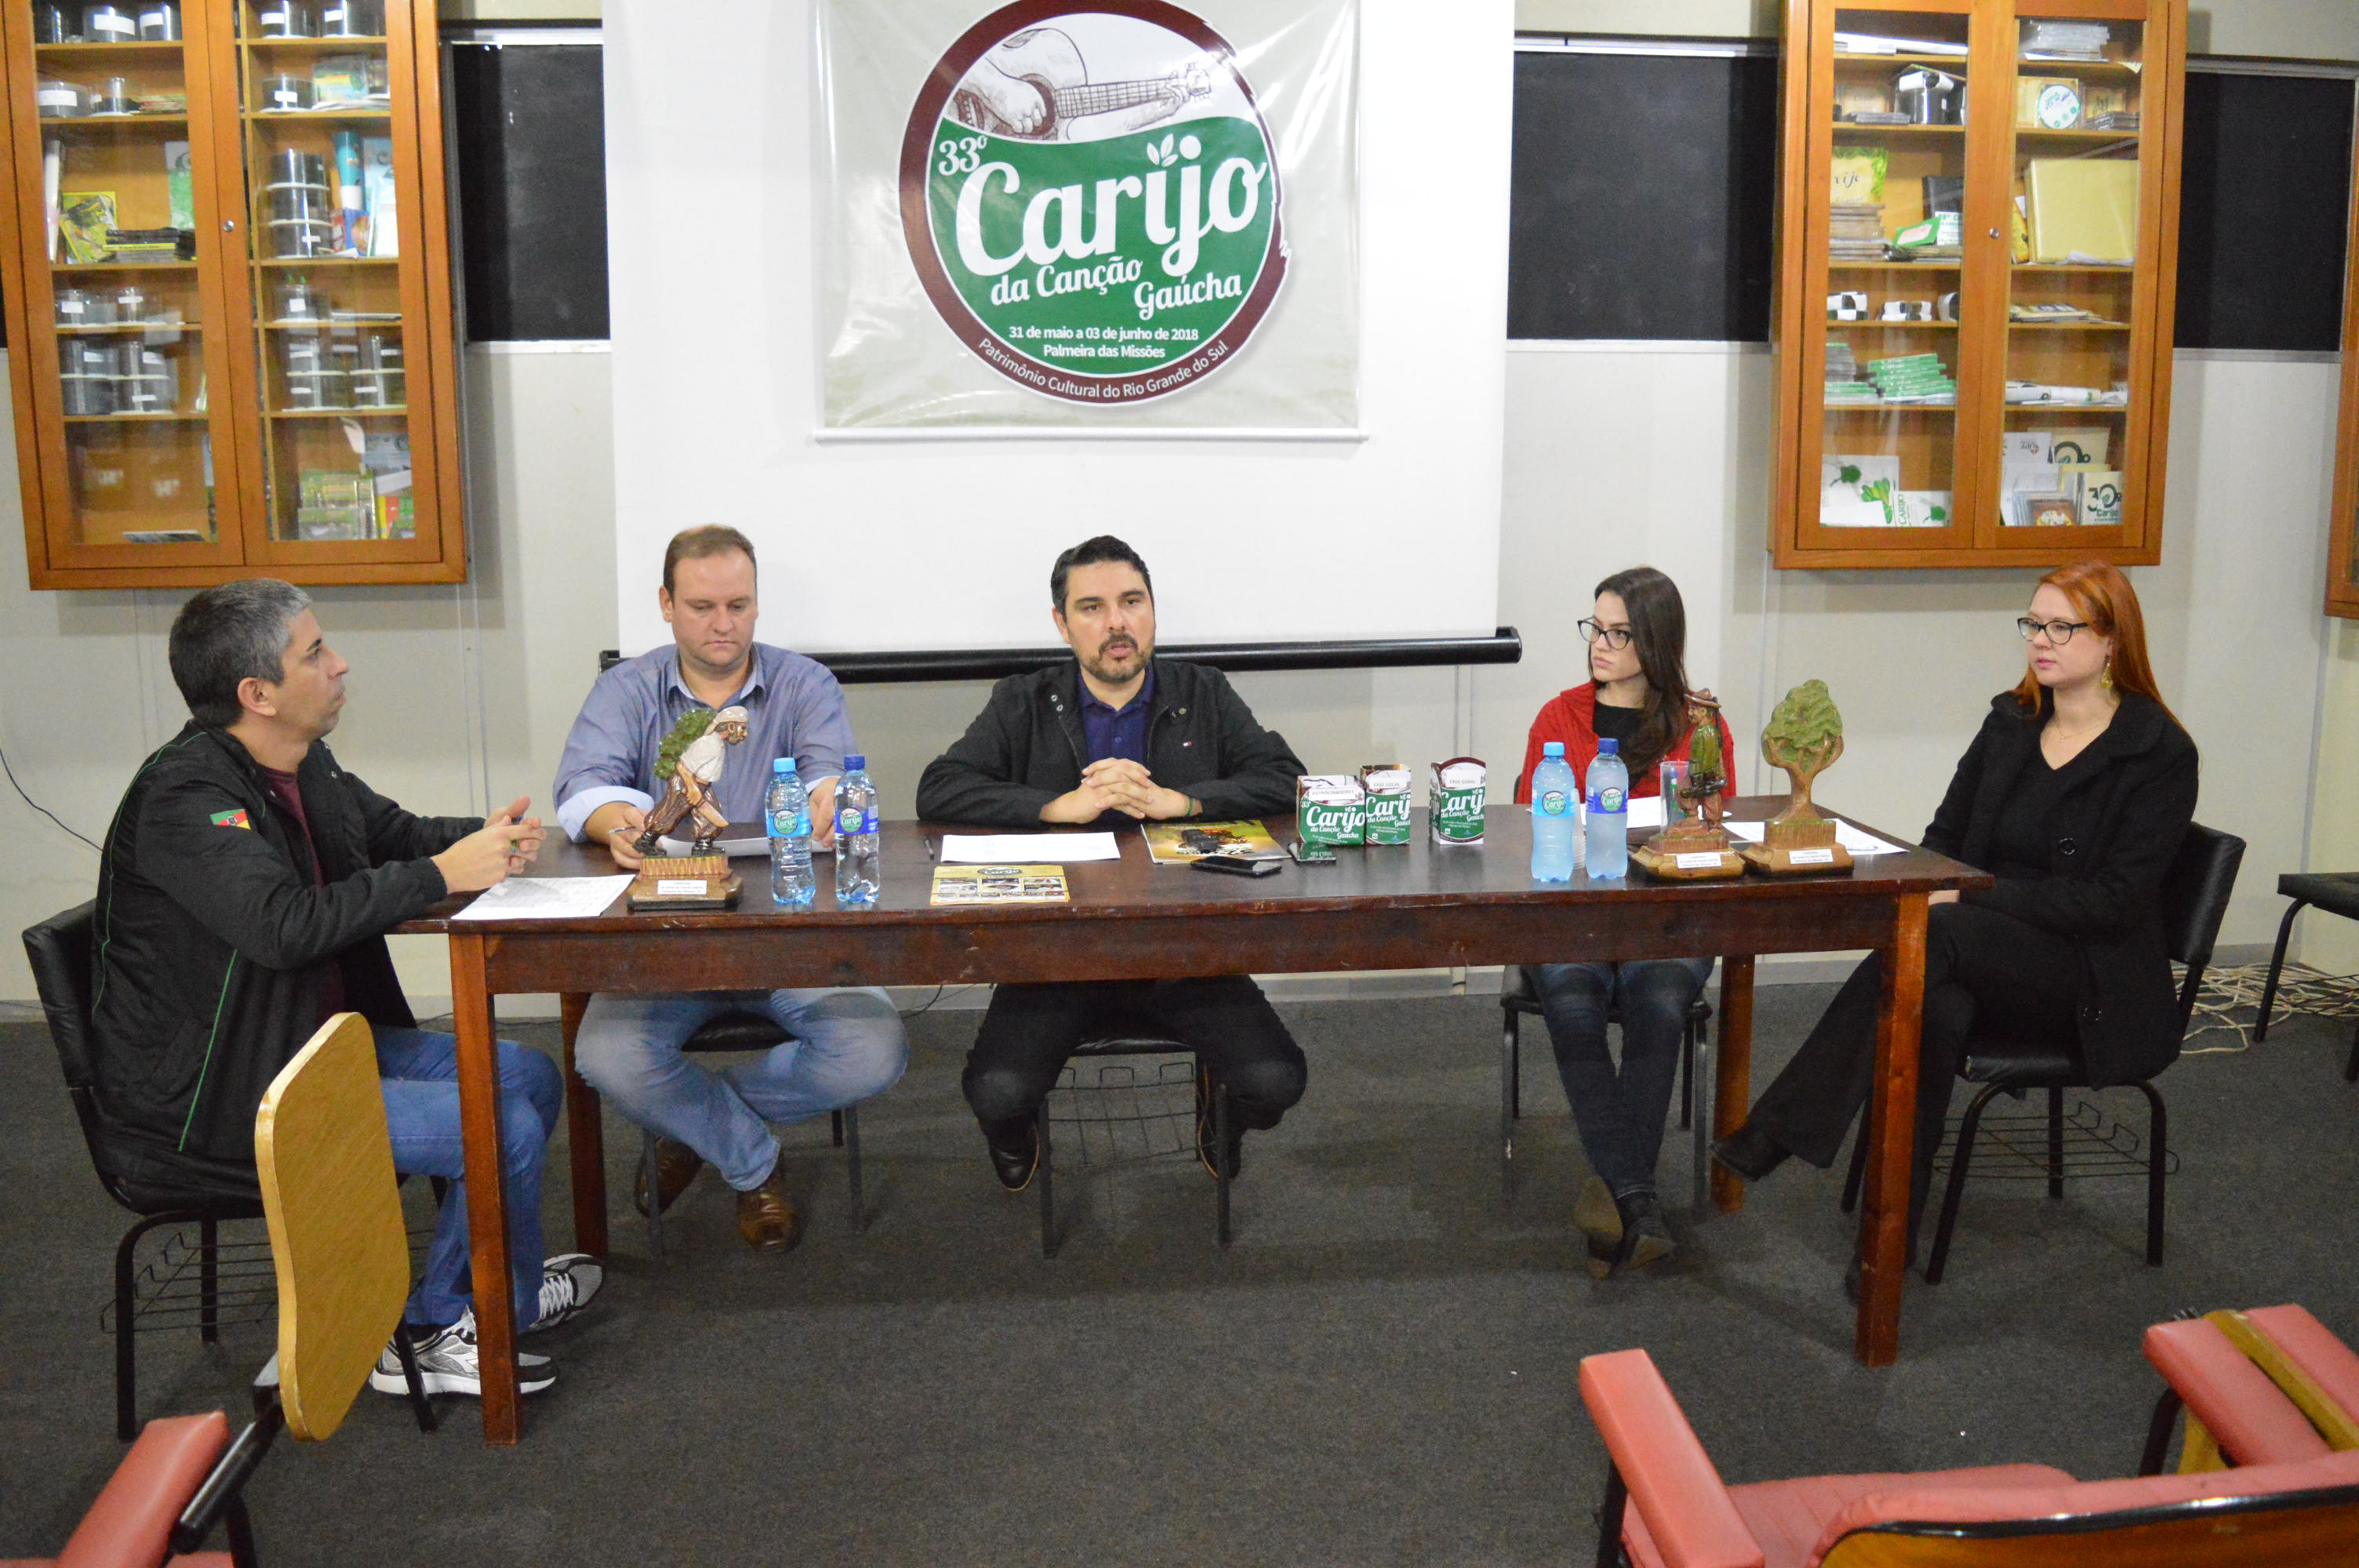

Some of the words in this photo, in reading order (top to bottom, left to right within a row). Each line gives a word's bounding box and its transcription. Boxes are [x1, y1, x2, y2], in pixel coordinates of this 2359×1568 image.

[956, 133, 1267, 277] Carijo
[990, 274, 1030, 305] da
[1036, 256, 1143, 297] Canção
[1134, 271, 1241, 321] Gaúcha
[1009, 326, 1023, 339] 31
[1026, 325, 1041, 339] de
[1044, 326, 1074, 339] maio
[1076, 329, 1084, 339] a
[1085, 327, 1100, 340] 03
[1102, 326, 1117, 340] de
[1118, 327, 1152, 343] junho
[1154, 327, 1169, 341] de
[1171, 328, 1198, 341] 2018
[1044, 343, 1095, 357] Palmeira
[1097, 344, 1119, 358] das
[1121, 344, 1166, 358] Missões
[979, 338, 1046, 387] Patrimônio
[1048, 376, 1100, 398] Cultural
[1103, 385, 1121, 398] do
[1123, 383, 1145, 397] Rio
[1146, 367, 1192, 393] Grande
[1191, 357, 1210, 374] do
[1208, 339, 1229, 361] Sul
[1306, 805, 1365, 833] Carijo
